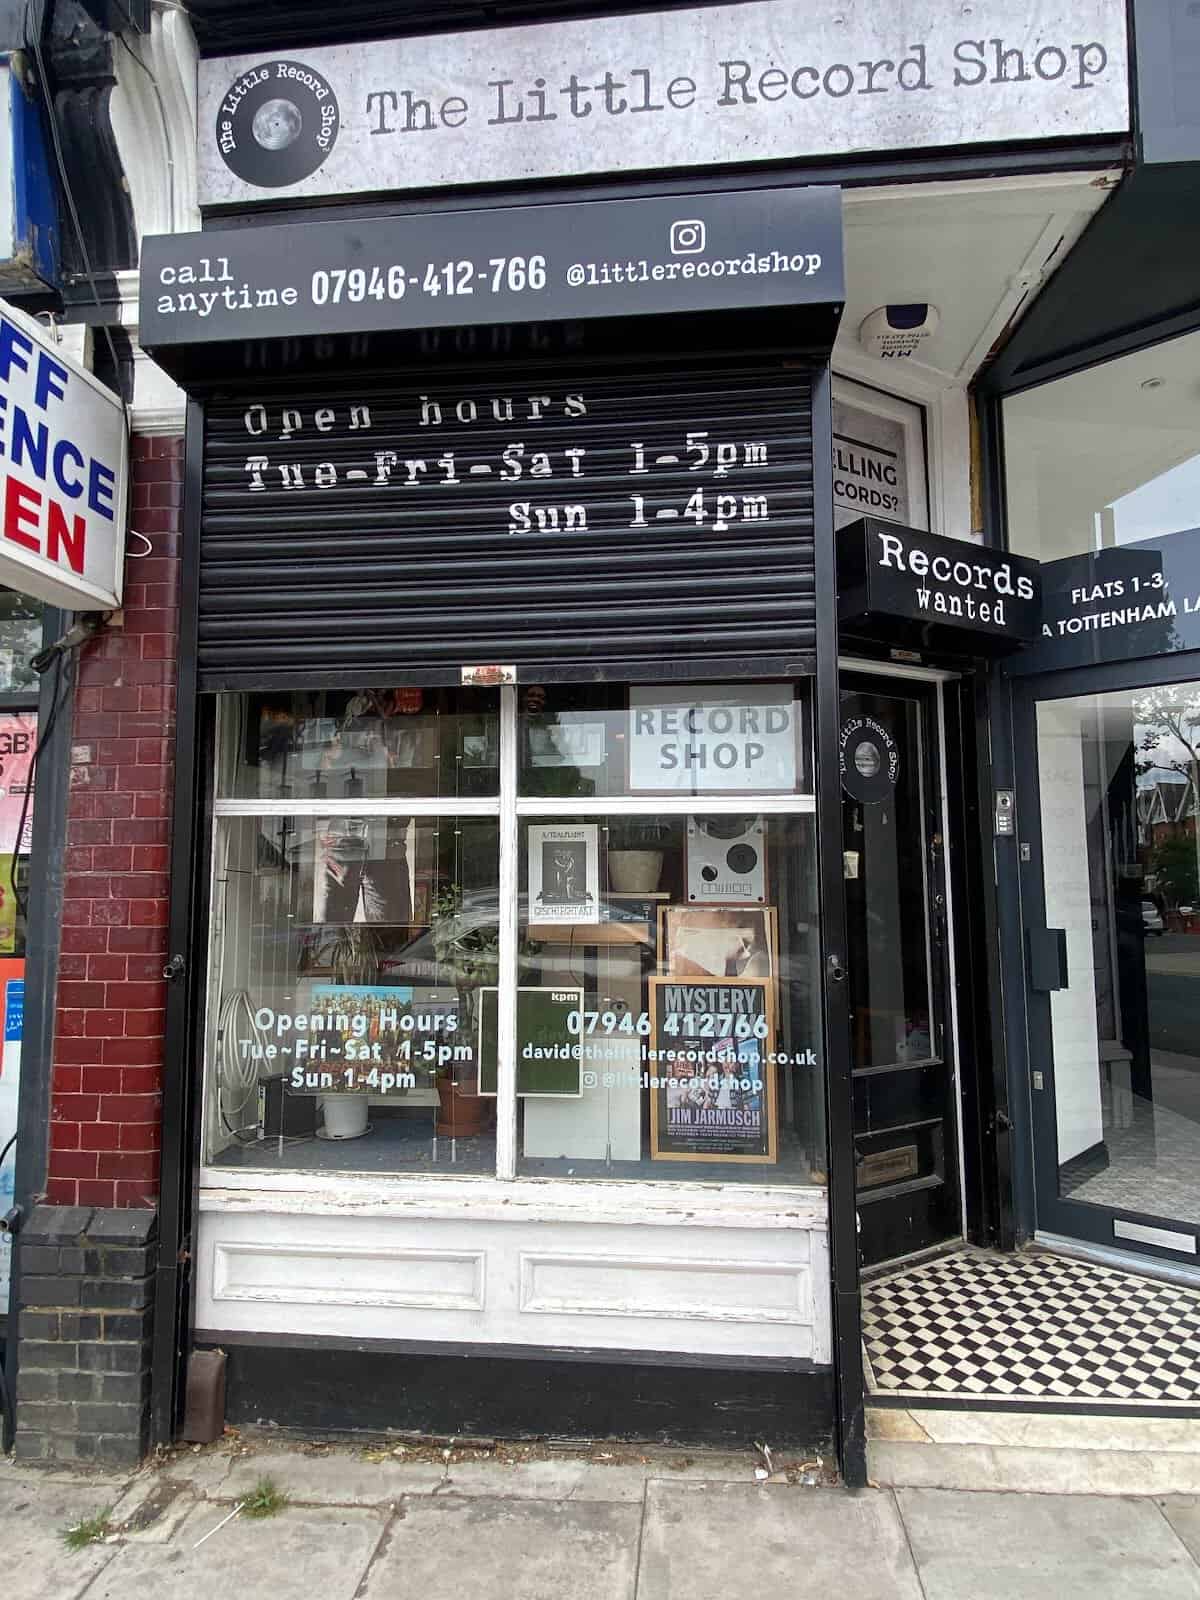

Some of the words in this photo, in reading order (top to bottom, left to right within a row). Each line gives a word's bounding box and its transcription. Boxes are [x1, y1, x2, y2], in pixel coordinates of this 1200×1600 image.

[222, 69, 270, 115] Little
[277, 64, 329, 100] Record
[366, 90, 469, 135] The
[488, 68, 697, 125] Little
[717, 44, 934, 106] Record
[952, 38, 1108, 90] Shop
[220, 120, 236, 154] The
[157, 283, 298, 317] anytime
[311, 255, 548, 306] 07946-412-766
[159, 257, 234, 285] call
[566, 251, 822, 287] @littlerecordshop
[243, 404, 371, 439] Open
[418, 393, 587, 427] hours
[0, 395, 115, 522] NCE
[244, 442, 586, 490] Tue-Fri-Sat
[628, 432, 769, 478] 1-5pm
[4, 474, 86, 575] EN
[508, 501, 589, 534] Sun
[628, 488, 770, 532] 1-4pm
[878, 532, 1034, 600] Records
[916, 588, 1006, 626] wanted
[1071, 580, 1125, 604] FLATS
[1057, 600, 1177, 635] TOTTENHAM
[635, 707, 789, 735] RECORD
[660, 742, 764, 769] SHOP
[551, 992, 578, 1002] kpm
[664, 985, 757, 1013] MYSTERY
[255, 1007, 368, 1037] Opening
[379, 1008, 458, 1031] Hours
[566, 1010, 652, 1035] 07946
[664, 1012, 769, 1039] 412766
[402, 1040, 473, 1065] 1-5pm
[290, 1066, 333, 1088] Sun
[344, 1067, 417, 1094] 1-4pm
[670, 1108, 691, 1124] JIM
[694, 1109, 760, 1126] JARMUSCH
